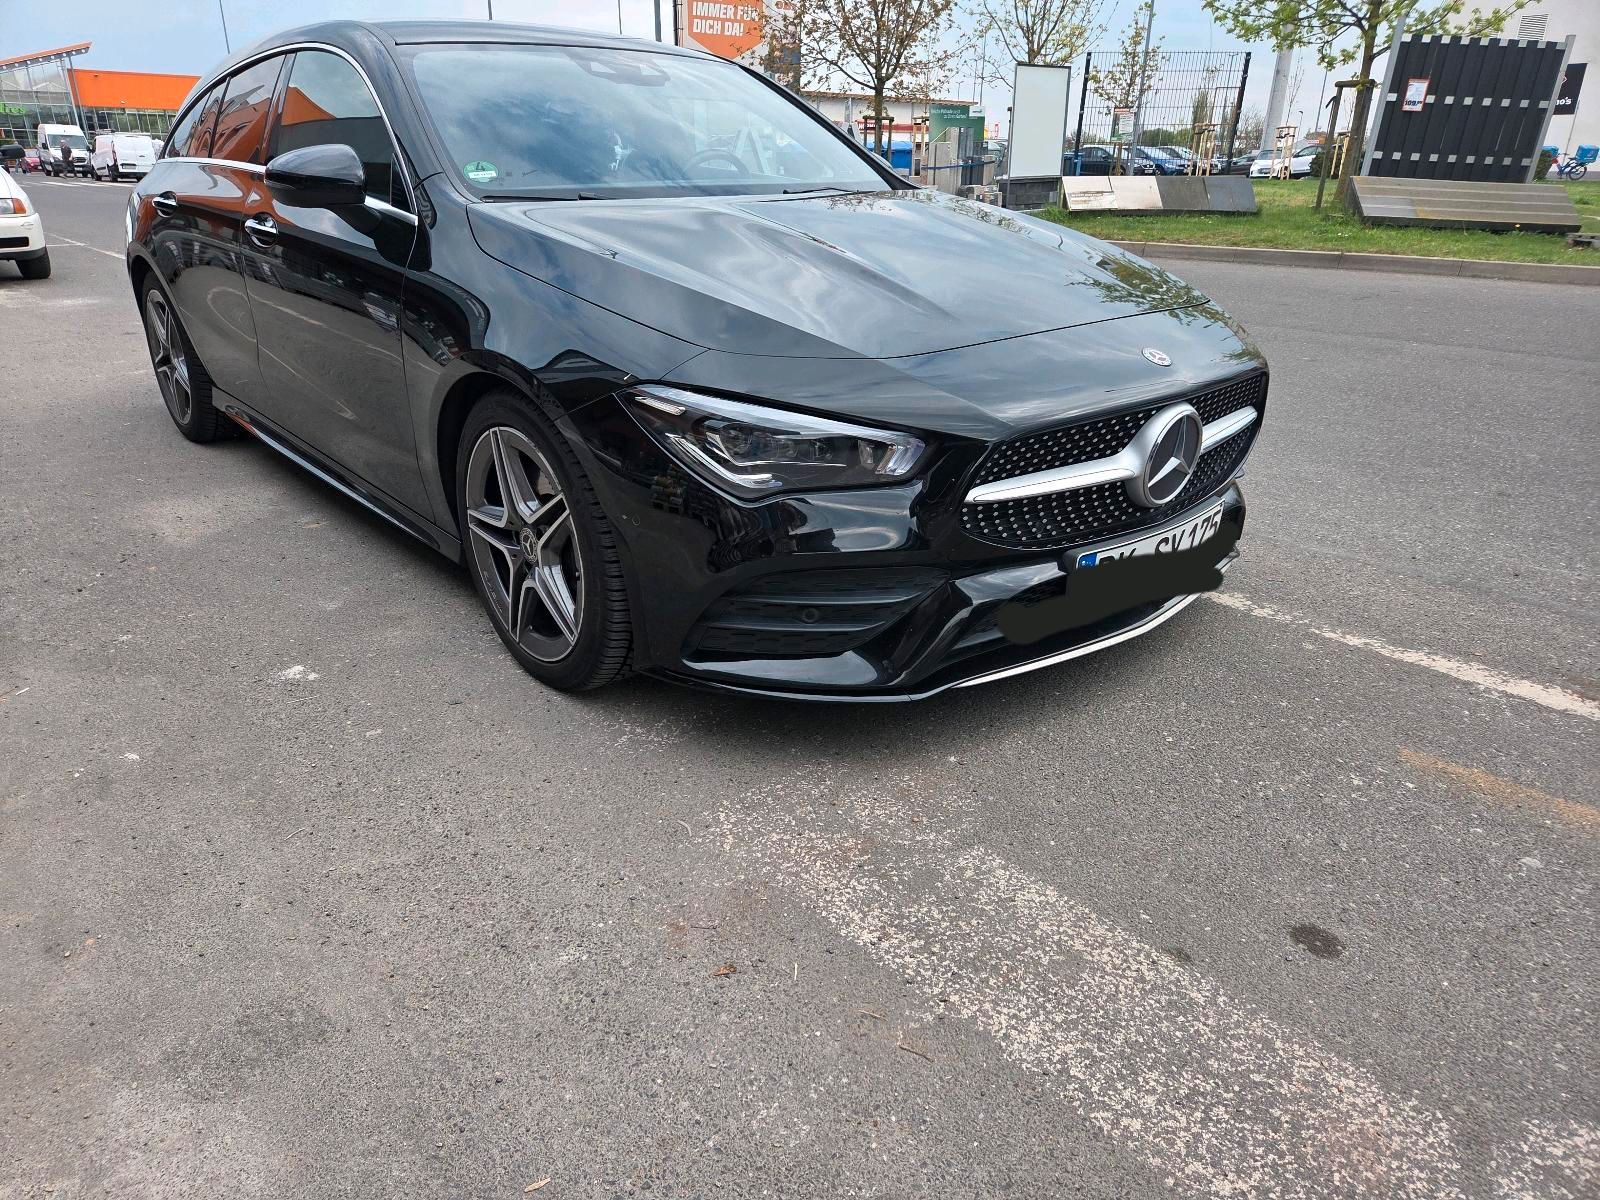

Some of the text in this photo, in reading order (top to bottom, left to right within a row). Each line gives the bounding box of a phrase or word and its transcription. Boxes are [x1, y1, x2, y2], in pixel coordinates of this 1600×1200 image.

[692, 2, 759, 22] IMMER FÜR
[693, 19, 744, 36] DICH DA!
